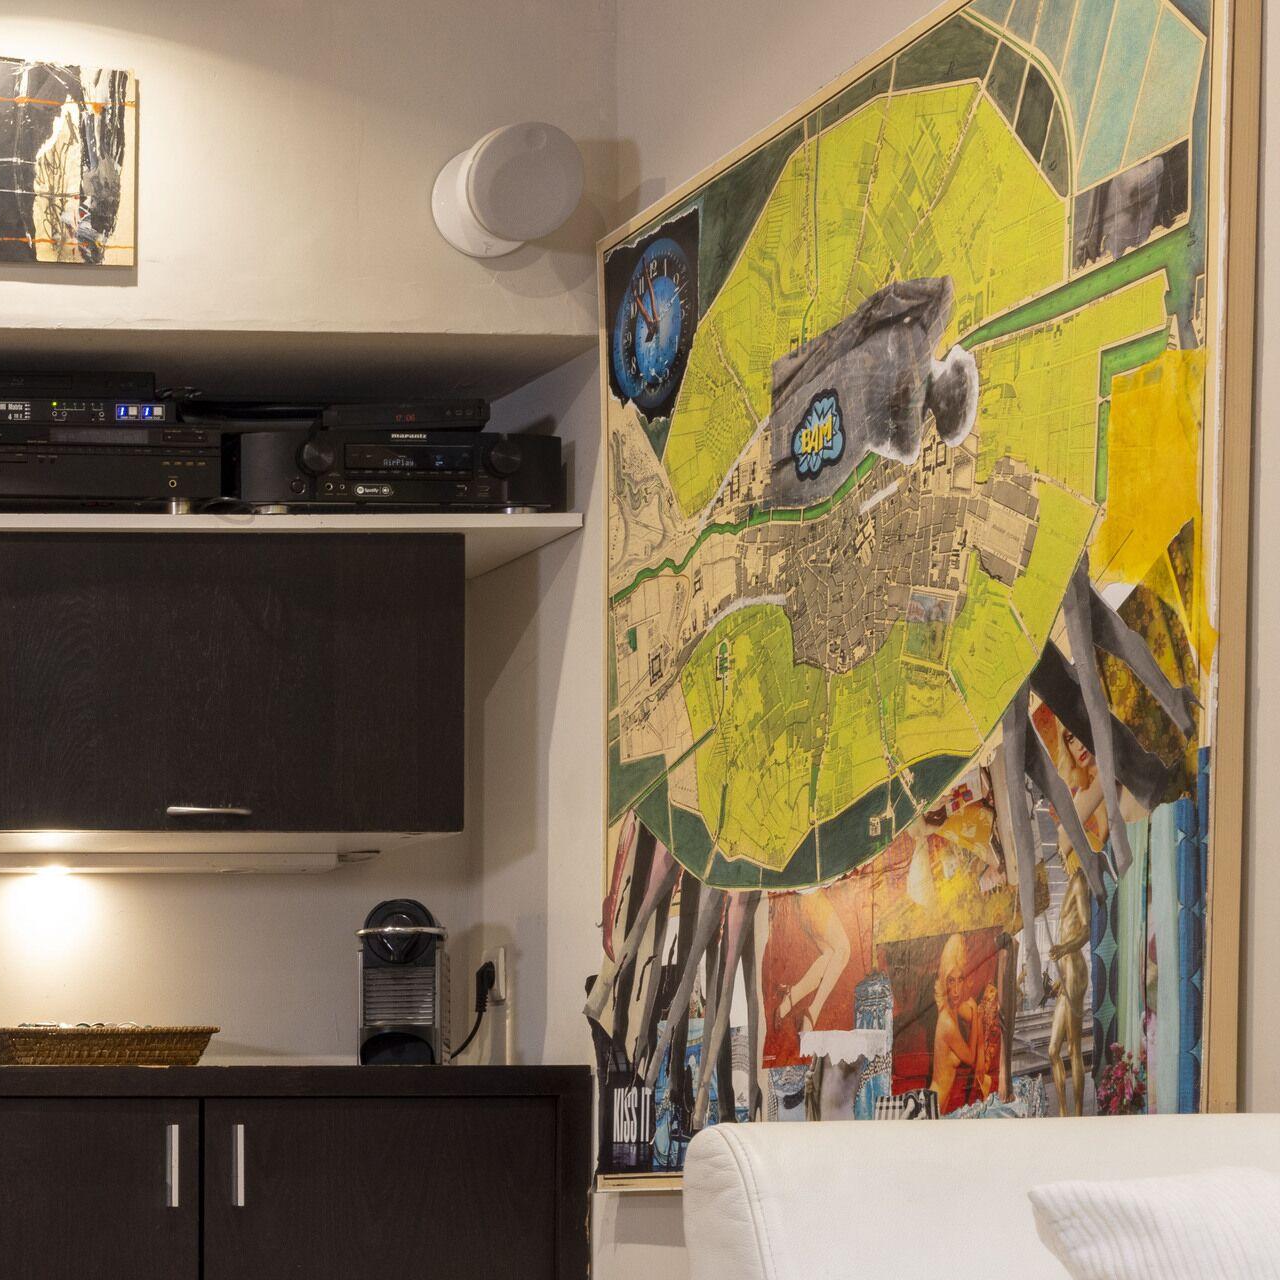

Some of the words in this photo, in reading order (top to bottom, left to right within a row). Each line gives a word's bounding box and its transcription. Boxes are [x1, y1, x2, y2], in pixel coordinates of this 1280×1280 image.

[799, 412, 835, 456] BAM
[383, 458, 414, 468] AirPlay
[613, 1087, 637, 1143] KISS
[639, 1086, 653, 1142] IT
